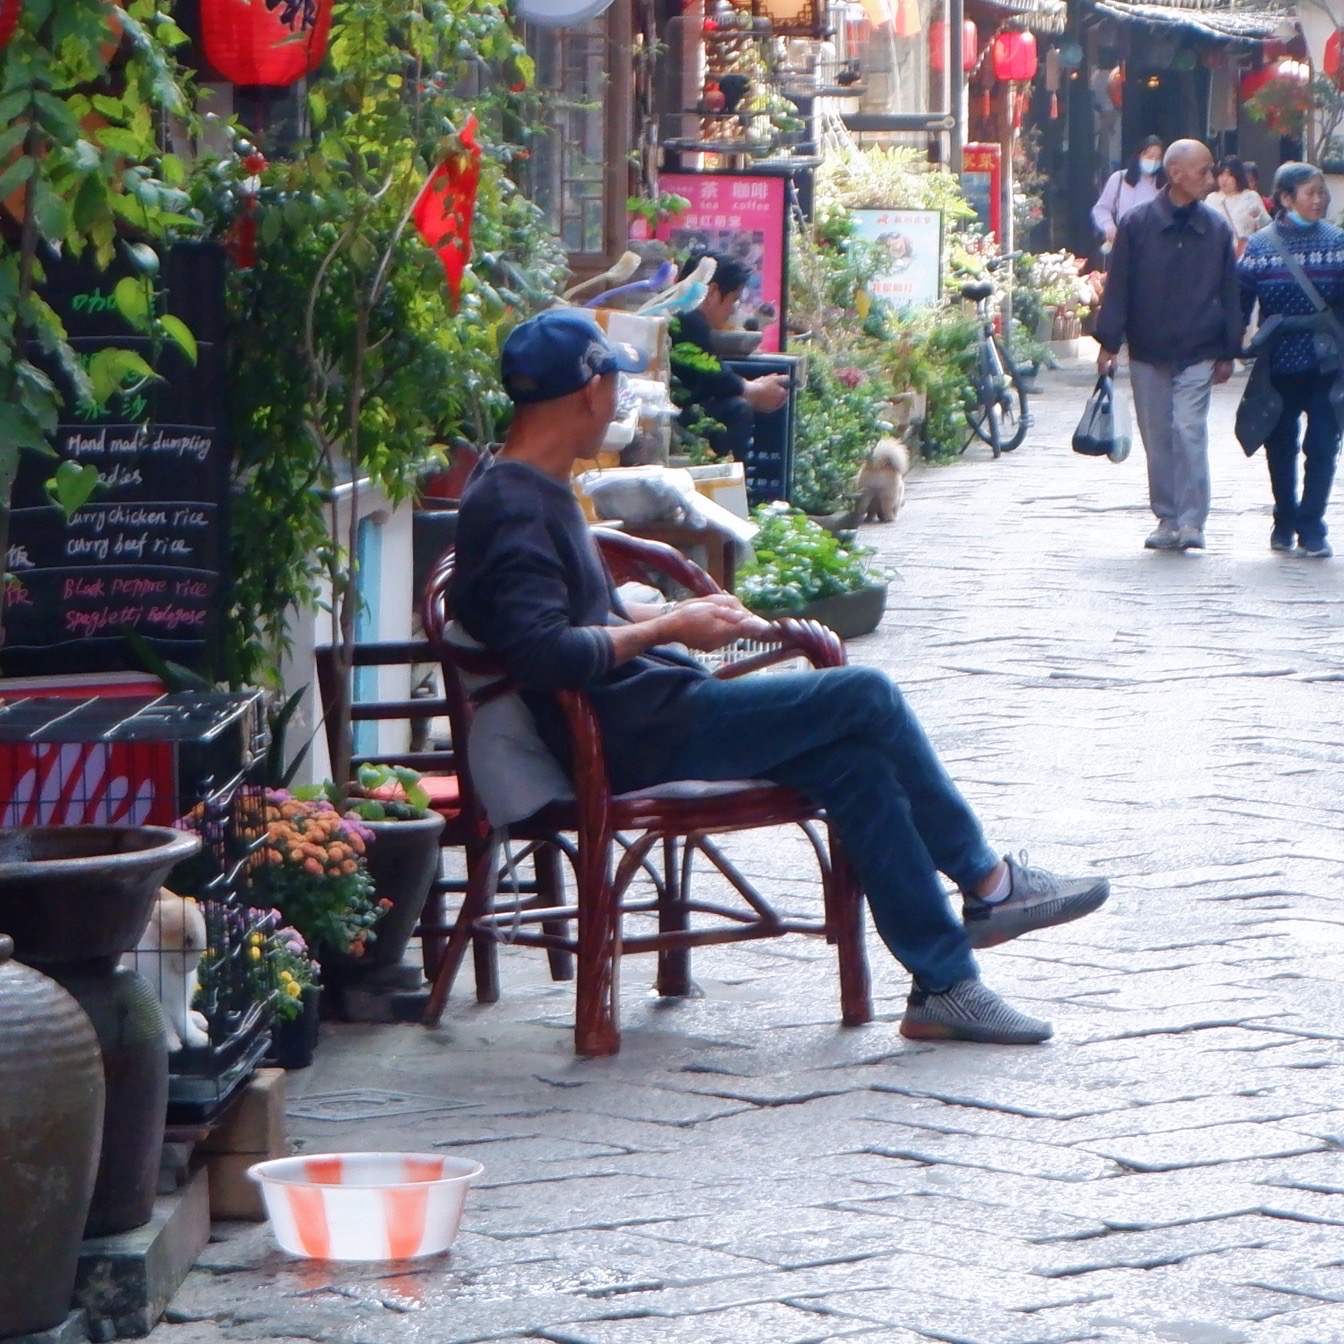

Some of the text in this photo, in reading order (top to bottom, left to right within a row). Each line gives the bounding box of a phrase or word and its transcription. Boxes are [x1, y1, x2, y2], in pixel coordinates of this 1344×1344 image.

[731, 181, 769, 200] 咖啡
[732, 200, 770, 212] coffee
[172, 508, 210, 527] rice
[114, 531, 149, 558] beef
[153, 537, 194, 556] rice
